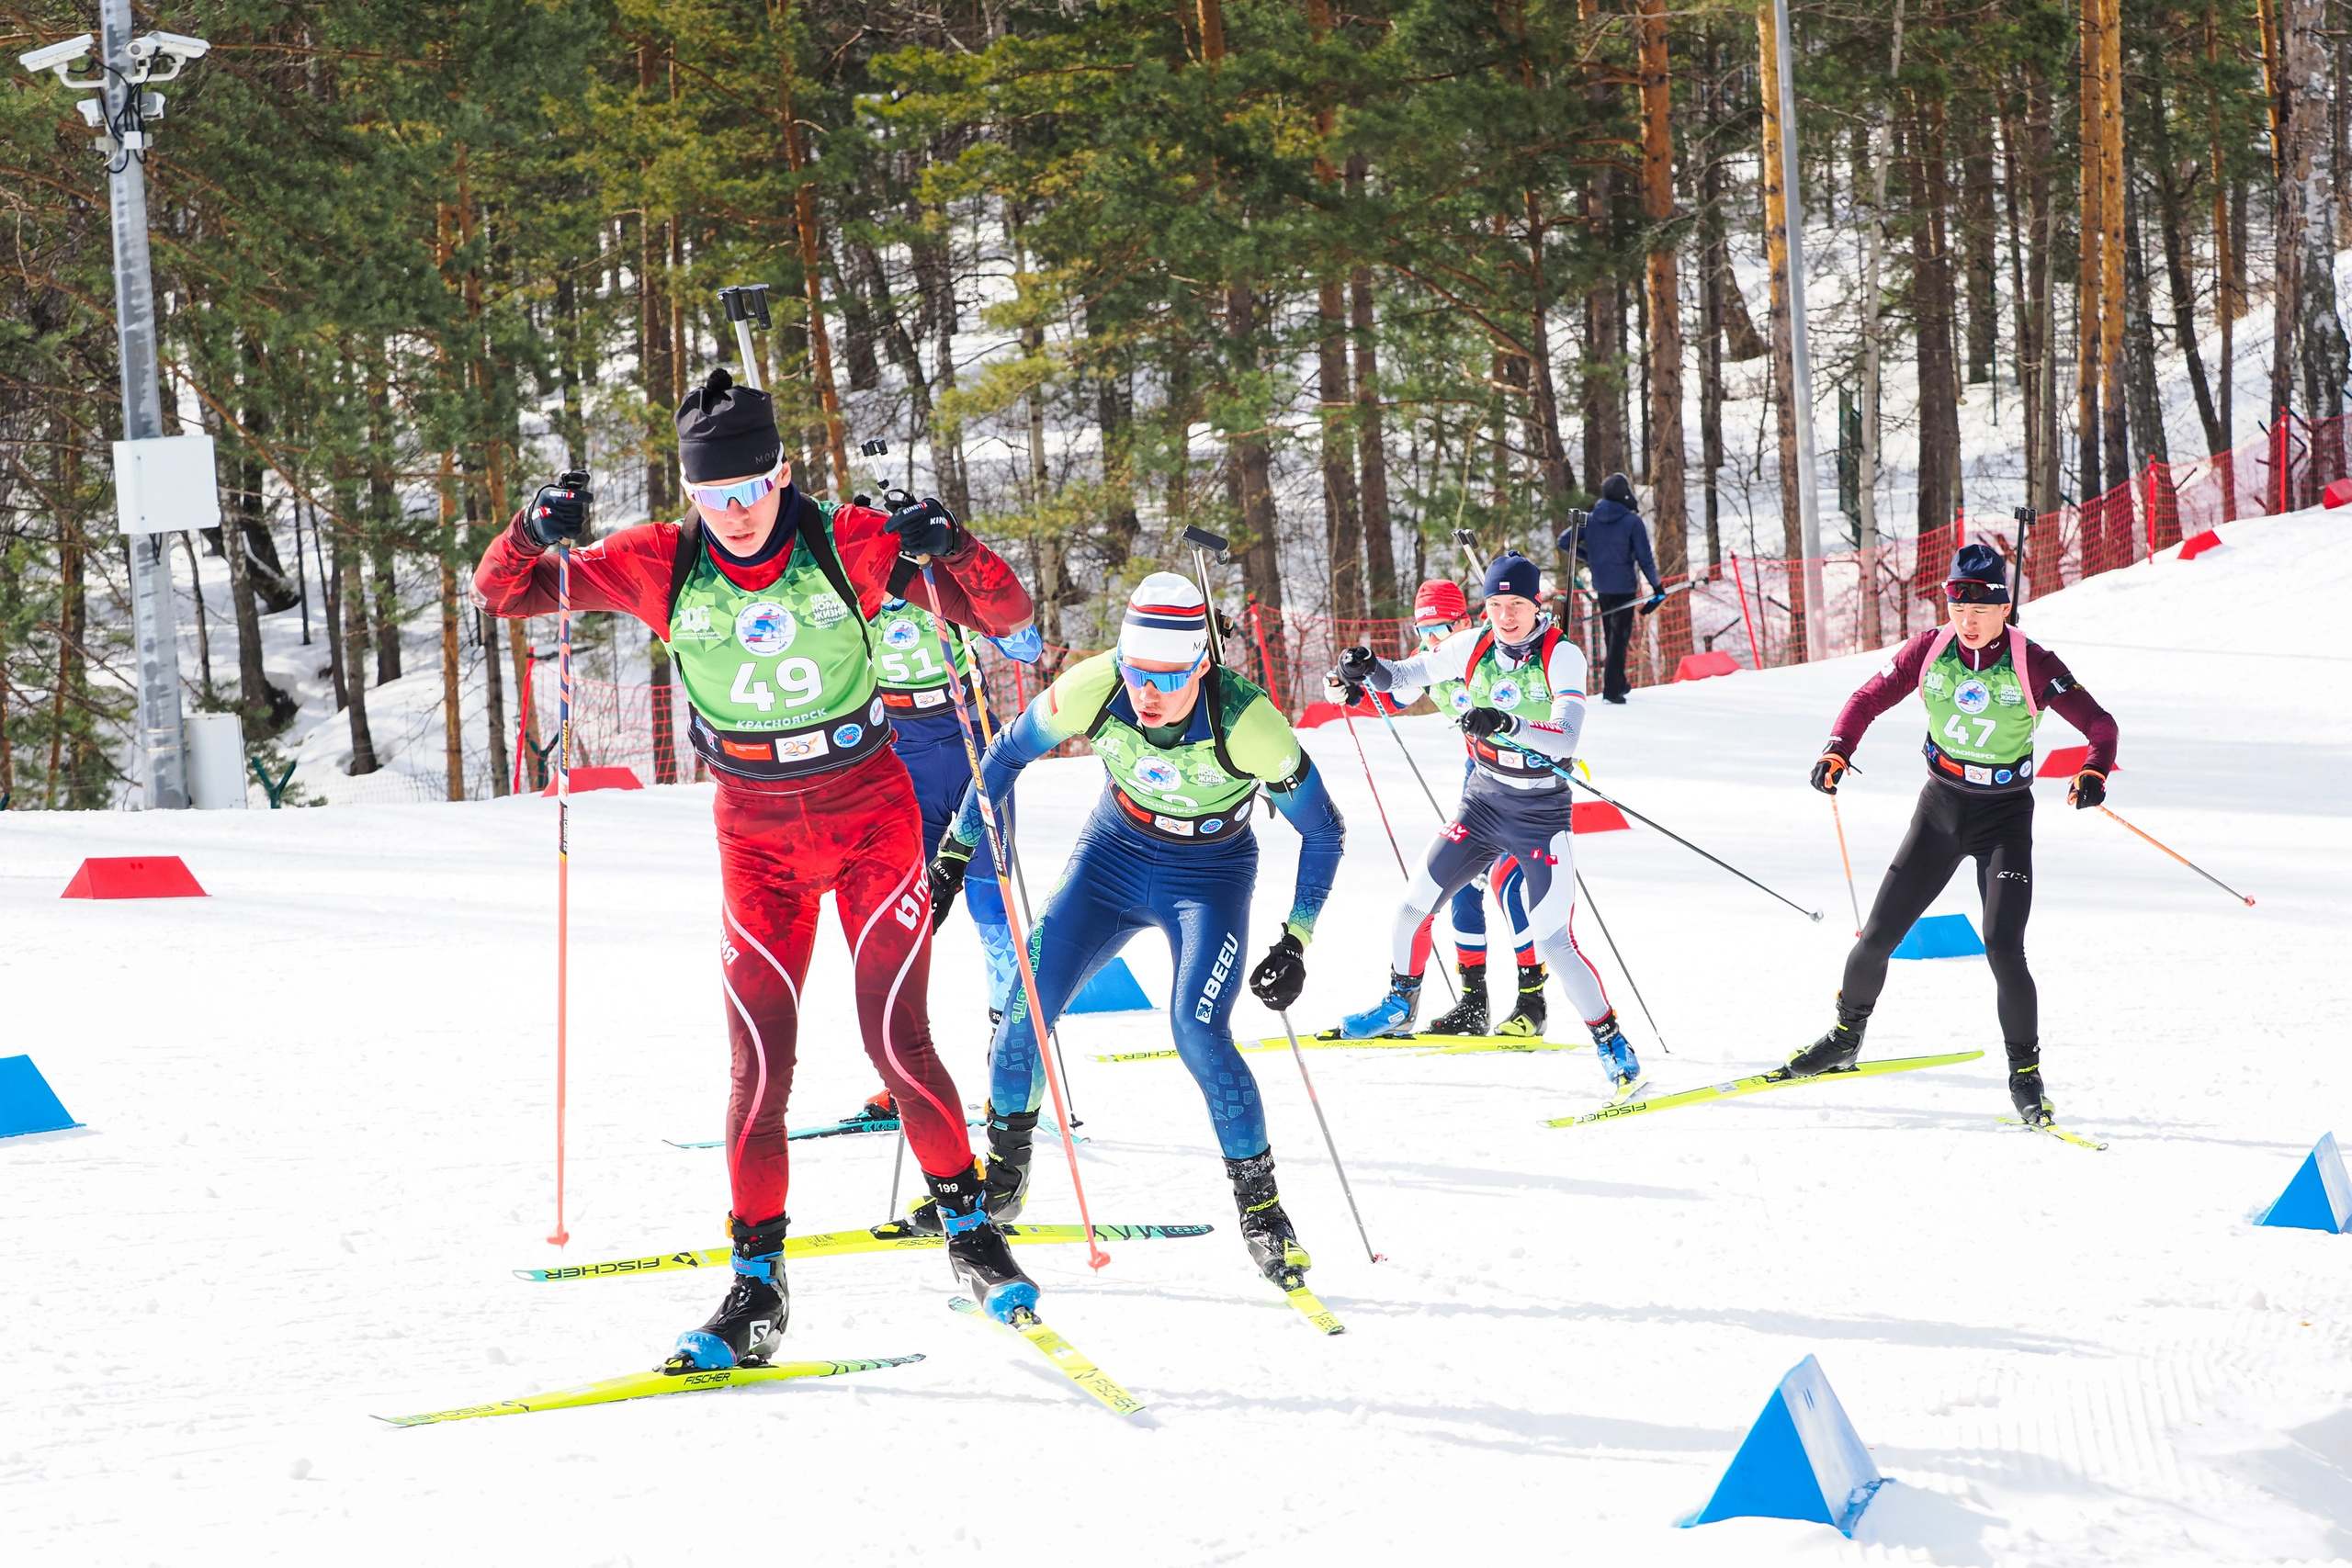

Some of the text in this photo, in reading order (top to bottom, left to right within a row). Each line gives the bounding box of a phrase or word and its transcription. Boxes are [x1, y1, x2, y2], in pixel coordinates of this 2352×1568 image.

[811, 600, 846, 613] НОРМА
[813, 606, 848, 621] ЖИЗНИ
[881, 648, 943, 682] 51
[729, 657, 823, 712] 49
[736, 707, 828, 729] КРАСНОЯРСК
[1943, 714, 1996, 748] 47
[964, 738, 985, 790] CHAMPION
[1946, 746, 1996, 760] КРАСНОЯРСК
[1011, 898, 1047, 1024] БЕЛОРУСНФТЬ
[1203, 931, 1239, 1000] BEEU
[1222, 956, 1241, 998] YOURSELF
[1123, 1050, 1179, 1060] SCHER
[937, 1182, 958, 1192] 199
[895, 1238, 944, 1247] FISCHE
[544, 1257, 661, 1280] FISCHER
[684, 1372, 731, 1385] FISCHER
[1089, 1378, 1136, 1411] FISCHER
